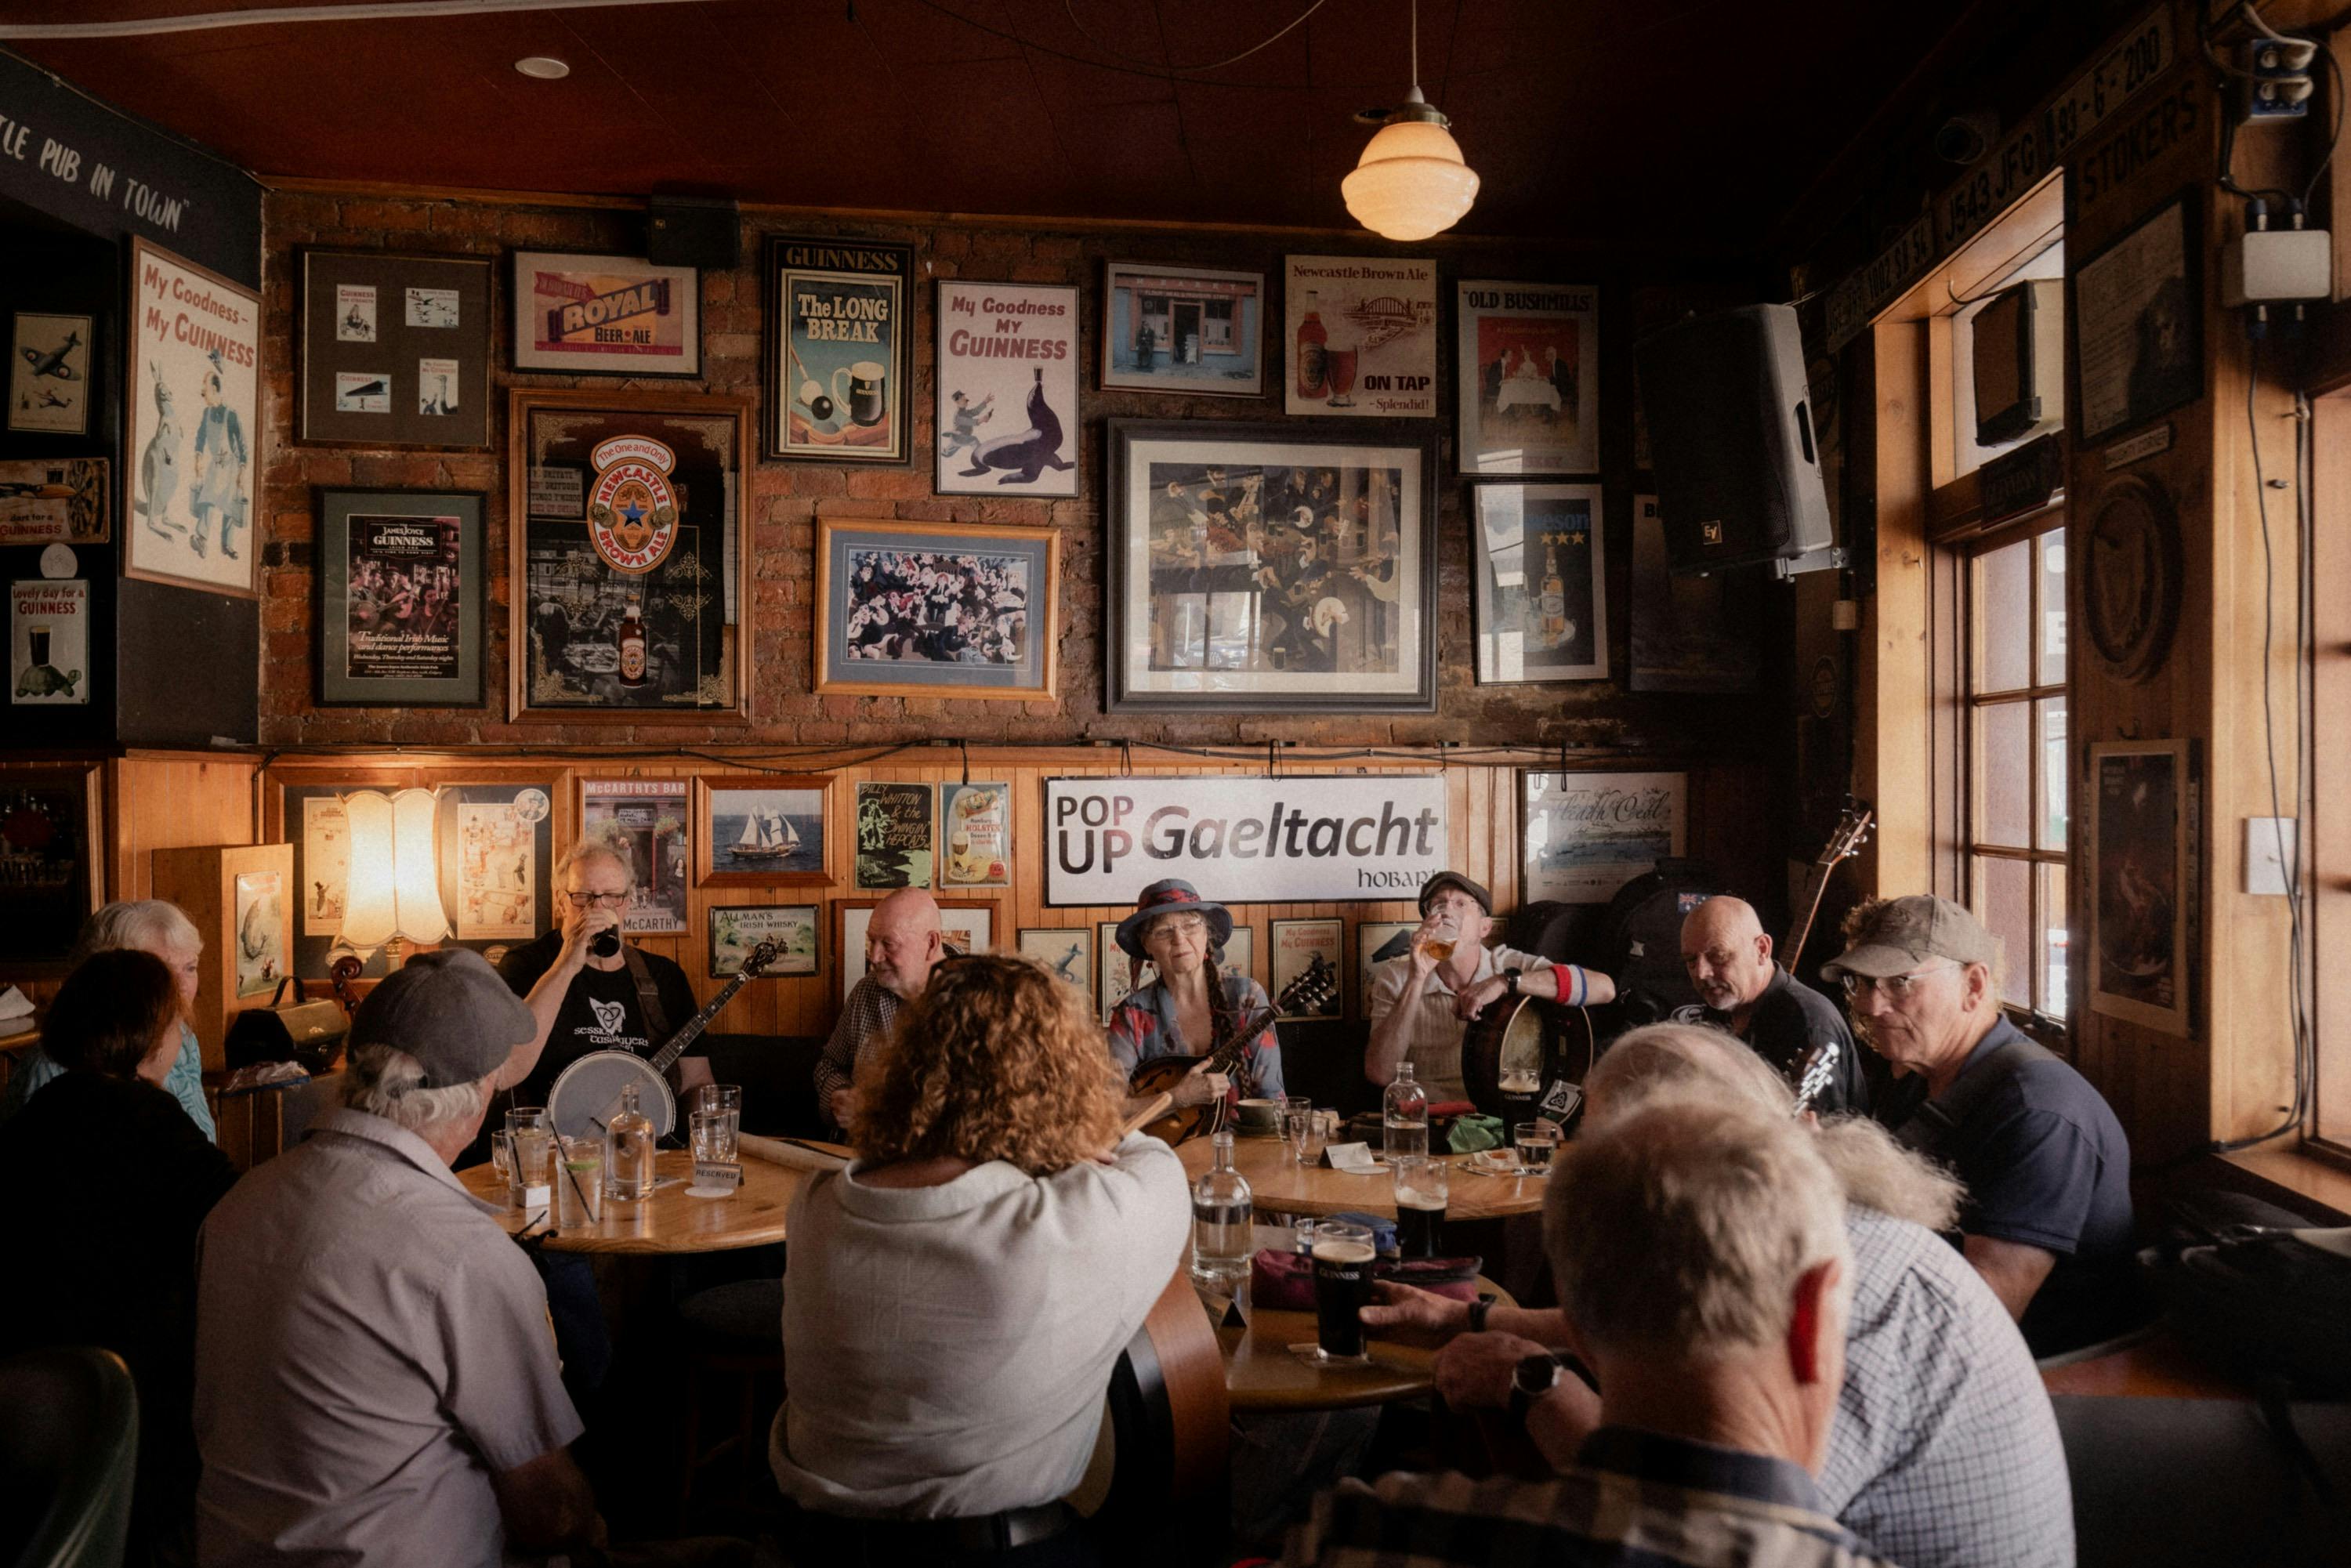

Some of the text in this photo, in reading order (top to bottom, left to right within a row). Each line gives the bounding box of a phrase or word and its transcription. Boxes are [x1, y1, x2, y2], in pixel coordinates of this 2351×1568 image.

[40, 137, 81, 182] PUB
[90, 163, 116, 201] IN
[786, 247, 899, 271] GUINNESS
[143, 264, 168, 300] My
[1294, 265, 1428, 281] Newcastle Brown Ale
[562, 284, 657, 333] ROYAL
[798, 294, 889, 321] The LONG
[951, 296, 1065, 317] My Goodness
[595, 327, 651, 343] BEER ALE
[807, 319, 879, 342] BREAK
[995, 319, 1022, 333] MY
[146, 306, 255, 368] My GUINNESS
[950, 329, 1067, 360] GUINNESS
[1364, 375, 1430, 390] ON TAP
[598, 444, 668, 464] The One and Only
[598, 466, 668, 503] NEWCASTLE
[372, 535, 434, 546] GUINNESS
[599, 531, 668, 566] BROWN ALE
[13, 588, 40, 599] Lovely
[43, 588, 59, 599] day
[62, 588, 76, 597] for
[19, 600, 76, 614] GUINNESS
[358, 630, 450, 643] Traditional Irish Music
[397, 643, 450, 654] performances
[663, 783, 686, 794] BAR
[860, 784, 889, 795] BILLY
[891, 805, 921, 819] & the
[1056, 795, 1134, 827] POP
[1142, 802, 1439, 860] Gaeltacht
[1058, 830, 1133, 875] UP
[623, 918, 679, 931] McCARTHY
[720, 911, 773, 923] ALLMAN'S
[695, 1169, 737, 1180] RESERVED
